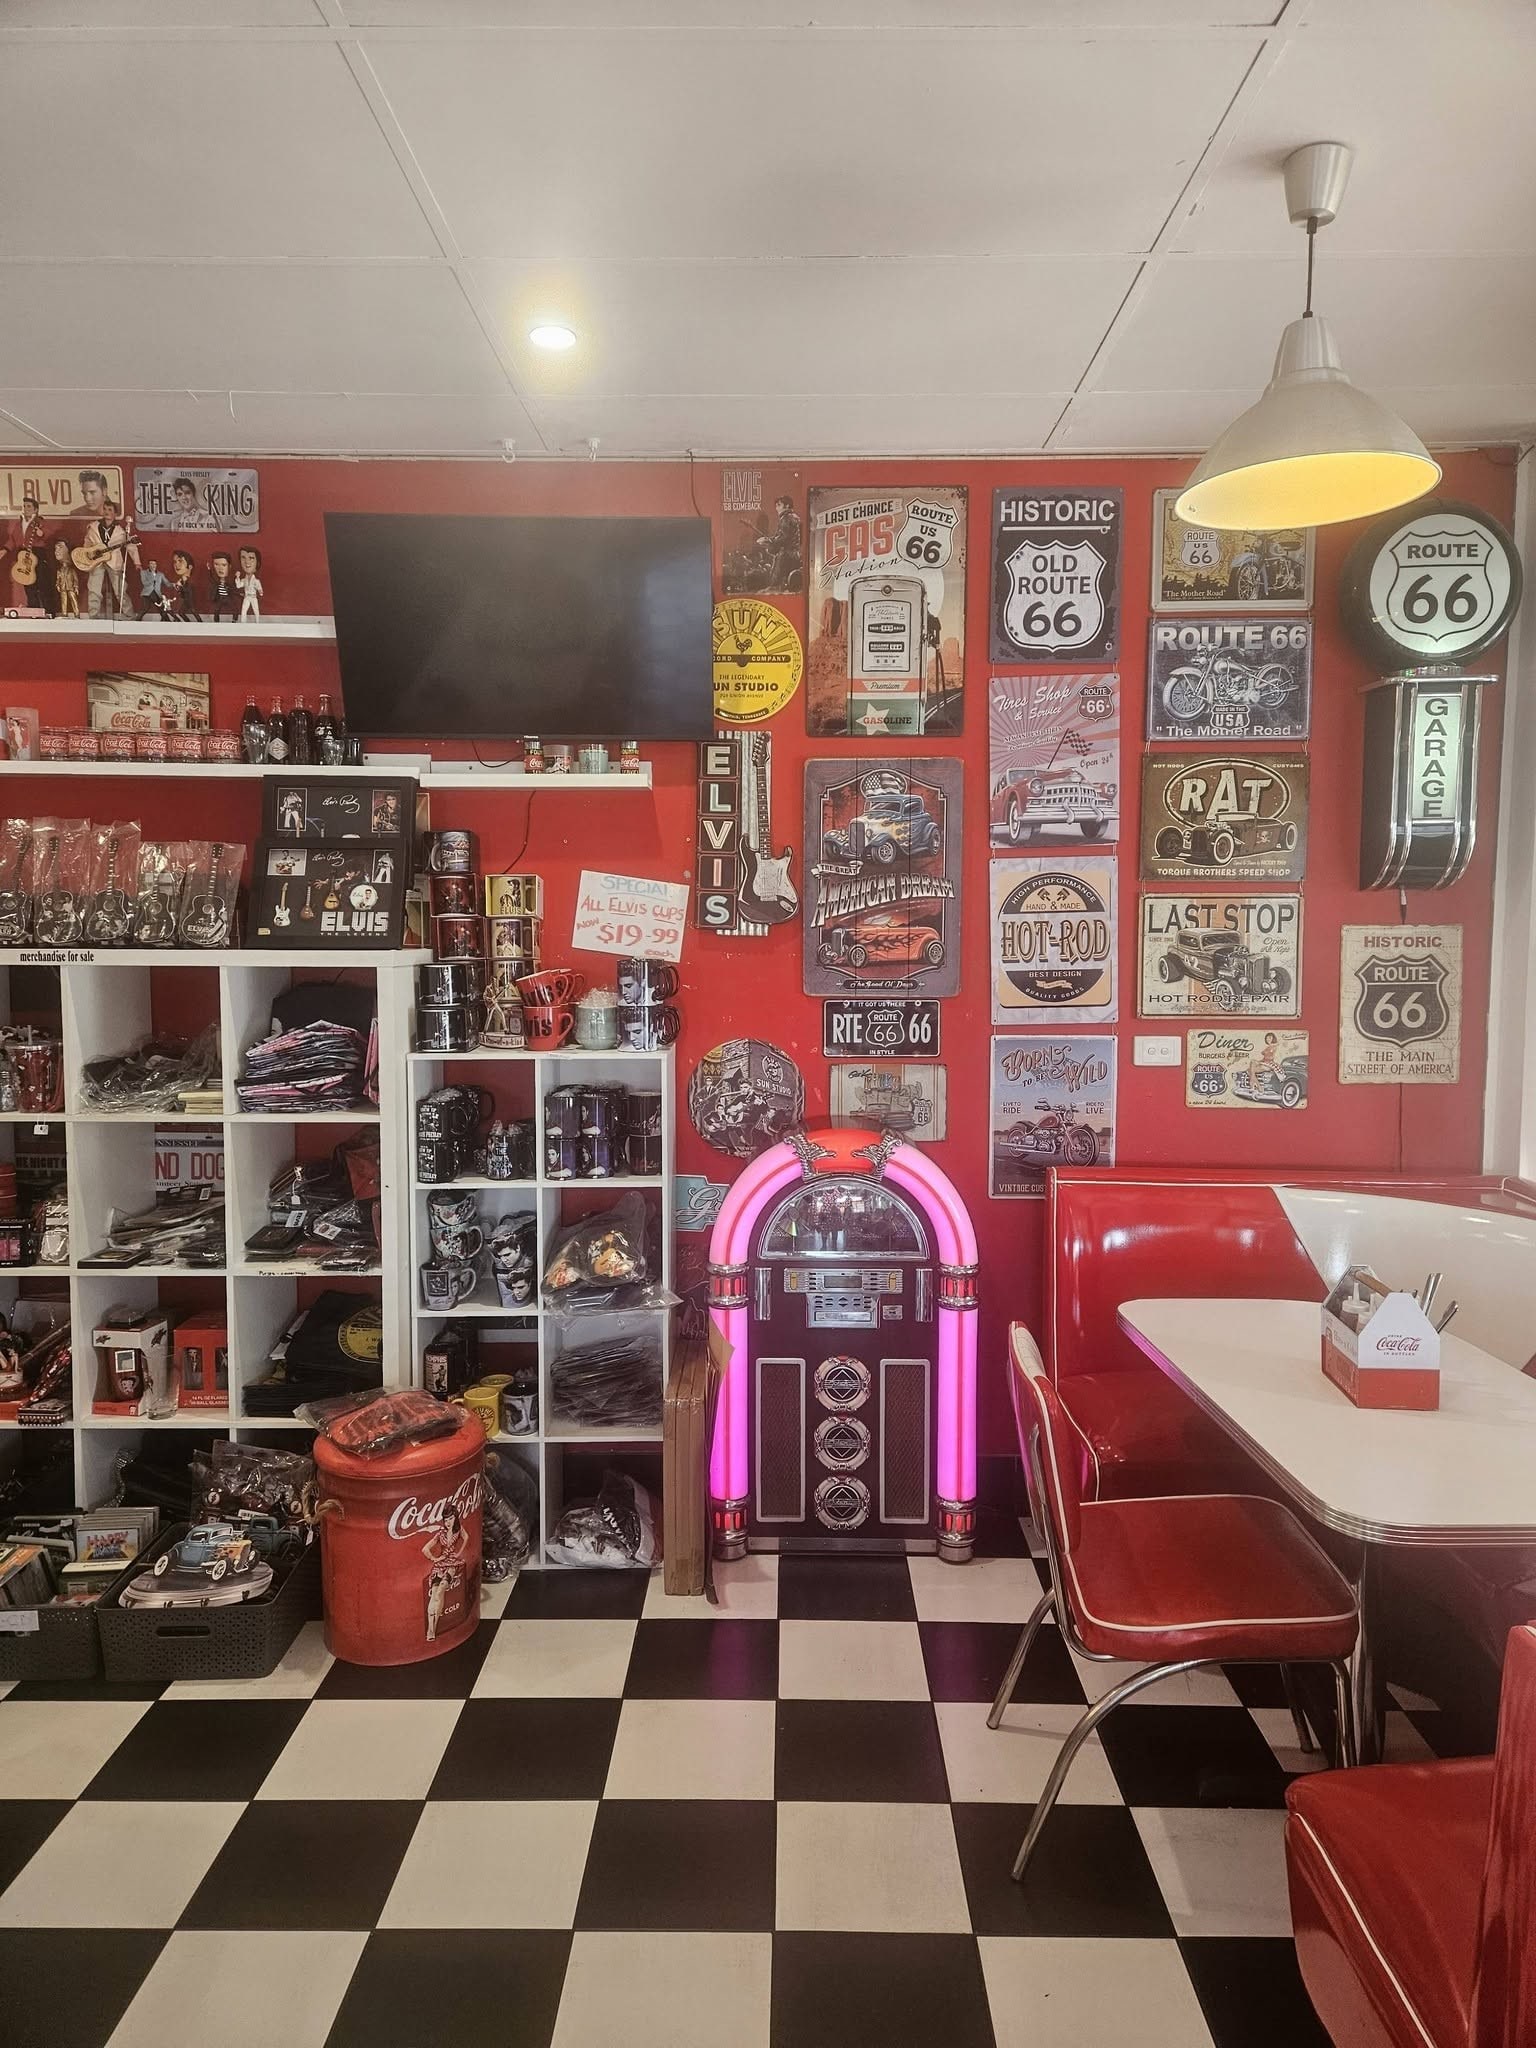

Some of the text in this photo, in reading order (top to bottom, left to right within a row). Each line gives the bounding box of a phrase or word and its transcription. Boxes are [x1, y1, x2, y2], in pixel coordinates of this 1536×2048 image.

[723, 471, 762, 502] ELVIS
[139, 482, 253, 516] THE KING
[733, 502, 762, 511] COMEBACK
[825, 501, 894, 525] LAST CHANCE
[911, 504, 954, 524] ROUTE
[1000, 500, 1115, 522] HISTORIC
[920, 525, 937, 537] US
[1187, 531, 1214, 540] ROUTE
[825, 515, 894, 567] GAS
[905, 535, 942, 564] 66
[1189, 550, 1212, 564] 66
[1407, 543, 1479, 559] ROUTE
[819, 553, 902, 588] Station
[1032, 554, 1078, 573] OLD
[1018, 576, 1091, 595] ROUTE
[1402, 573, 1479, 624] 66
[712, 610, 777, 641] SUN
[1022, 600, 1082, 638] 66
[1157, 625, 1307, 651] ROUTE 66
[713, 682, 779, 692] UN STUDIO
[870, 681, 901, 691] Premium
[1083, 686, 1108, 696] ROUTE
[1034, 684, 1072, 705] Shop
[1029, 705, 1063, 720] Service
[1086, 700, 1106, 713] 66
[111, 712, 150, 728] Coca-Cola
[863, 717, 912, 725] GASOLINE
[1215, 714, 1244, 727] USA
[1166, 725, 1291, 737] The Mother Road
[1080, 758, 1098, 769] Open
[1420, 698, 1449, 818] GARAGE
[1179, 769, 1273, 821] RAT
[703, 745, 734, 925] ELVIS
[820, 864, 857, 874] THE GREAT
[1157, 868, 1290, 877] TORQUE BROTHERS SPEED SHOP
[600, 876, 667, 896] SPECIAL
[1011, 877, 1097, 905] HIGH PERFORMANCE
[581, 895, 684, 921] ALL ELVIS CUPS
[811, 872, 955, 928] AMERICAN DREAM
[1050, 901, 1057, 911] &
[320, 911, 389, 932] ELVIS
[577, 917, 599, 930] NOW
[1148, 904, 1295, 934] LAST STOP
[1001, 919, 1111, 965] HOT-ROD
[1263, 937, 1288, 947] Open
[1364, 936, 1442, 948] HISTORIC
[20, 950, 94, 962] merchandise for sale
[1052, 970, 1082, 978] DESIGN
[1374, 967, 1429, 981] ROUTE
[1025, 986, 1085, 999] QUALITY GOODS
[1149, 995, 1290, 1003] HOT ROD REPAIR
[1373, 992, 1427, 1028] 66
[526, 1015, 553, 1037] vis
[833, 1013, 862, 1043] RTE
[874, 1025, 897, 1042] 66
[909, 1013, 931, 1044] 66
[1197, 1031, 1254, 1052] Diner
[1366, 1051, 1435, 1062] THE MAIN
[1001, 1045, 1108, 1093] BORN WILD
[1348, 1063, 1452, 1075] STREET OF AMERICA
[756, 1078, 793, 1096] SUN STUDIO
[1022, 1078, 1032, 1087] TO
[1199, 1080, 1219, 1093] 66
[918, 1112, 929, 1122] 66
[157, 1139, 198, 1147] NNESSEE
[190, 1152, 225, 1180] DOG
[999, 1184, 1029, 1193] VINTAGE
[1376, 1336, 1421, 1352] Coca-Cola
